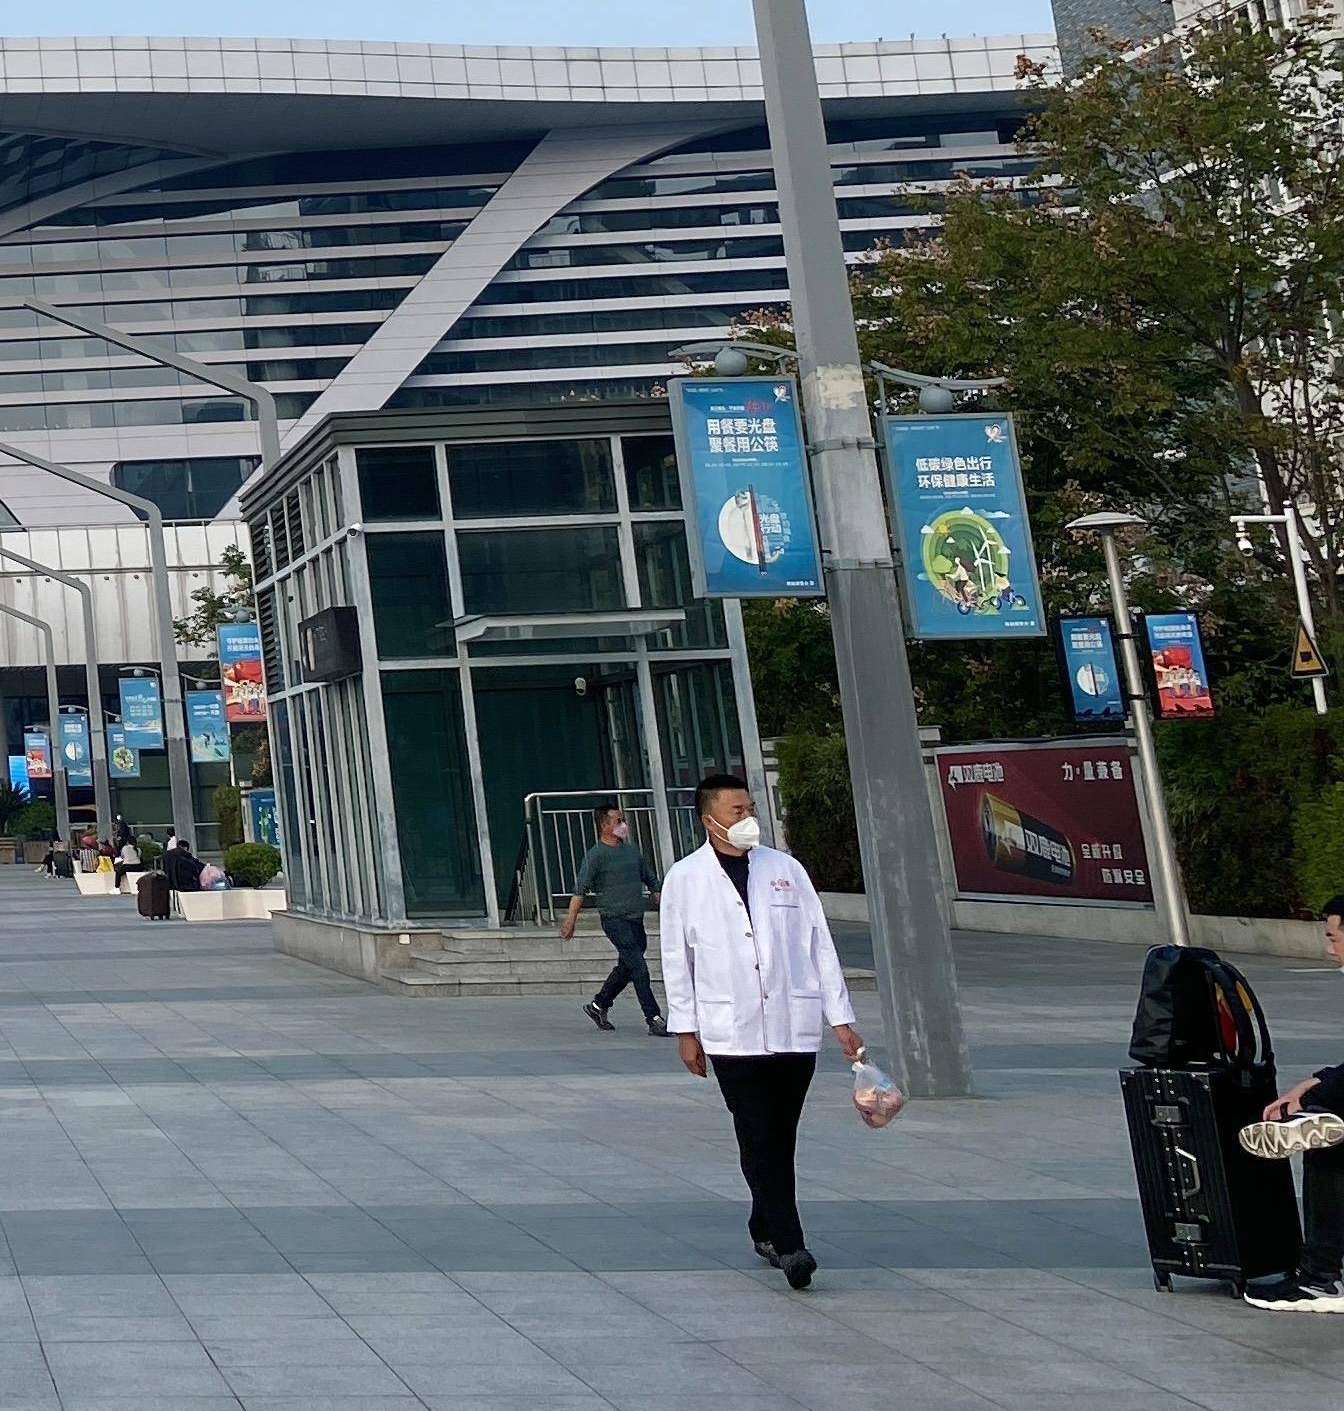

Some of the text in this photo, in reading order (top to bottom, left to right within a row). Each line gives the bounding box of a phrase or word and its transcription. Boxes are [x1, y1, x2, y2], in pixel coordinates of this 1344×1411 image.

[706, 417, 777, 435] 用餐要光盘
[708, 436, 779, 453] 聚餐用公筷
[915, 455, 992, 472] 低碳绿色出行
[917, 472, 996, 488] 环保健康生活
